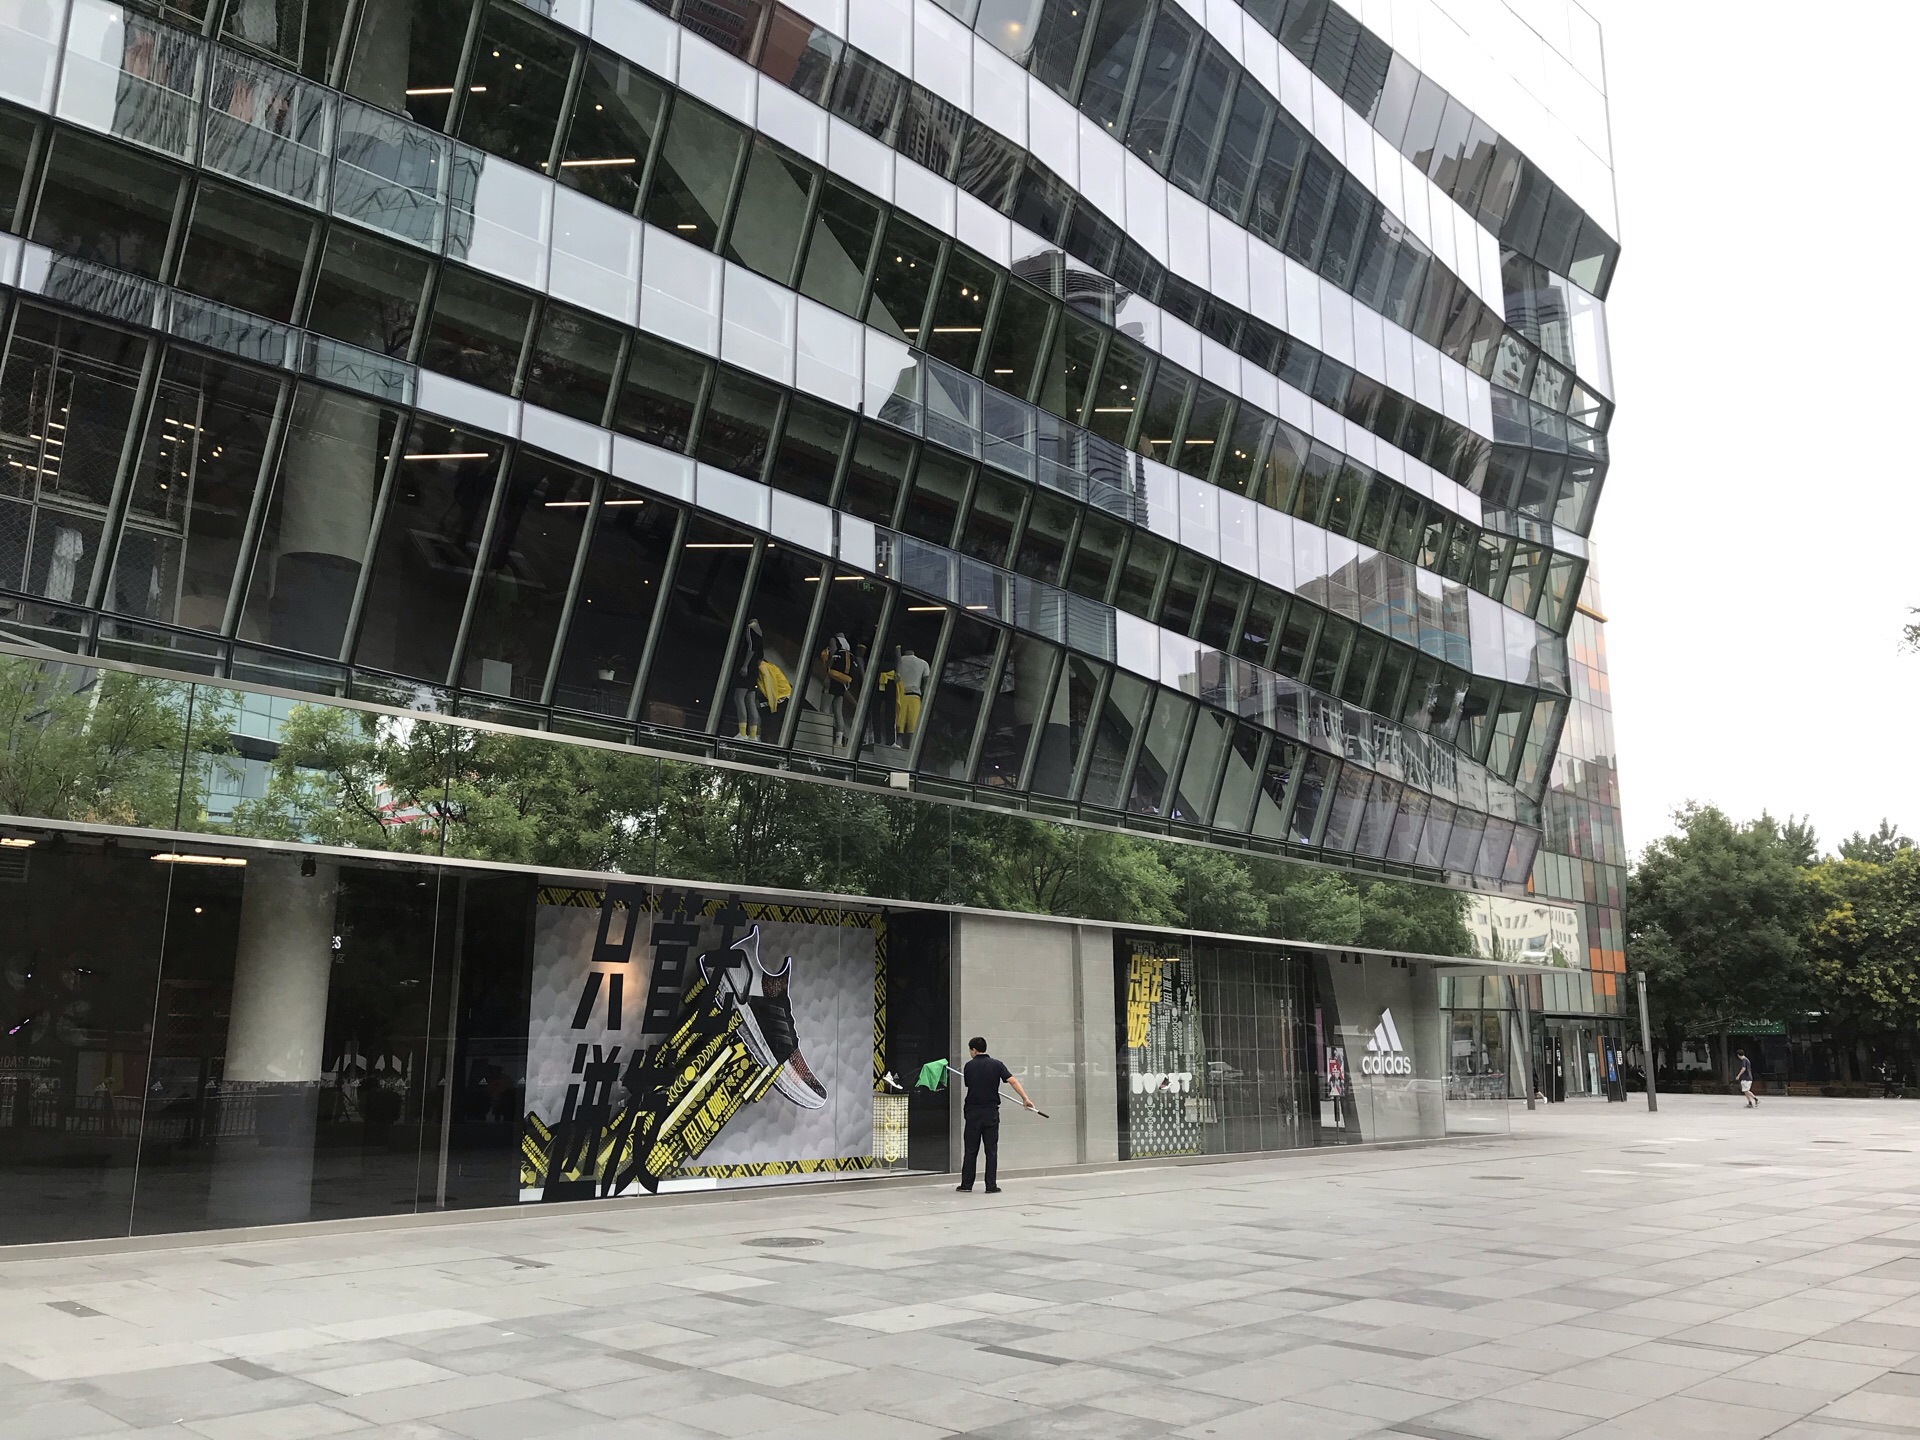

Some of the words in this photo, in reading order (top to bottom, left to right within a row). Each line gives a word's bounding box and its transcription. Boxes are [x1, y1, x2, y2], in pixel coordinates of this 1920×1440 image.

[1362, 1050, 1412, 1075] adidas
[682, 1120, 703, 1150] FEEL
[695, 1105, 714, 1134] THE
[706, 1082, 732, 1120] BOOST
